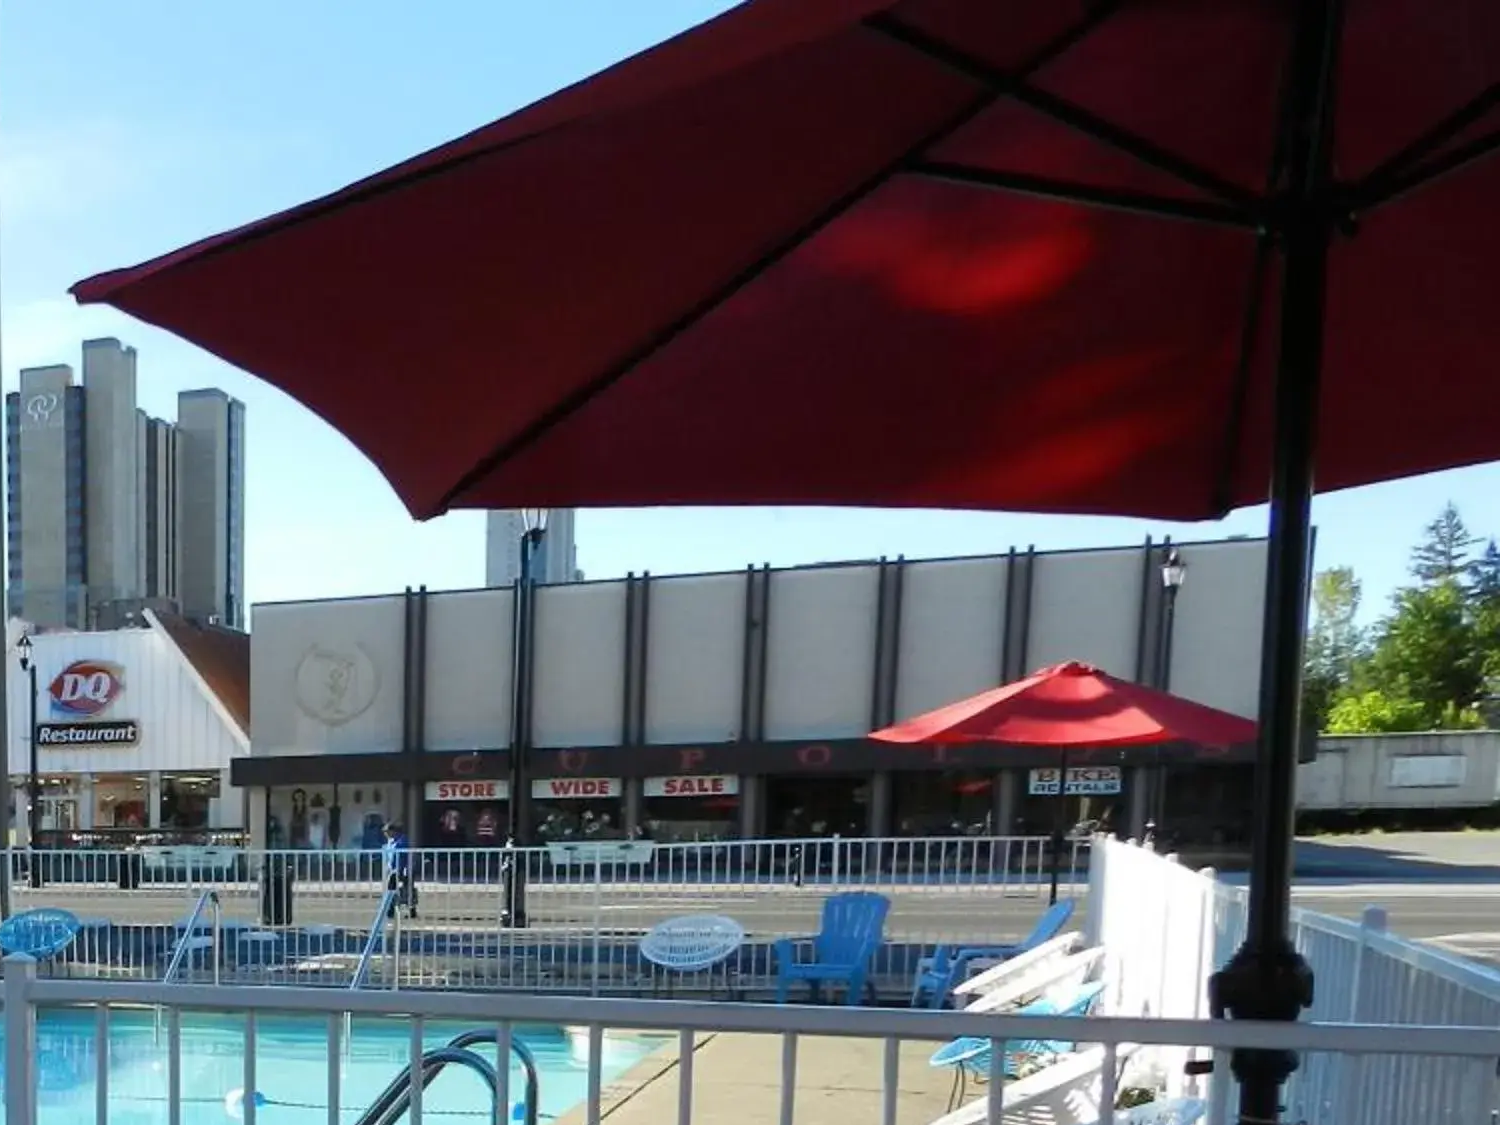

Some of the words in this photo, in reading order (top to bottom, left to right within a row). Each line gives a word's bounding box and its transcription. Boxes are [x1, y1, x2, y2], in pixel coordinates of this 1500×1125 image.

[59, 671, 111, 703] DQ
[39, 725, 136, 744] Restaurant
[1038, 766, 1117, 781] BKE
[438, 782, 497, 798] STORE
[550, 779, 610, 796] WIDE
[663, 776, 724, 794] SALE
